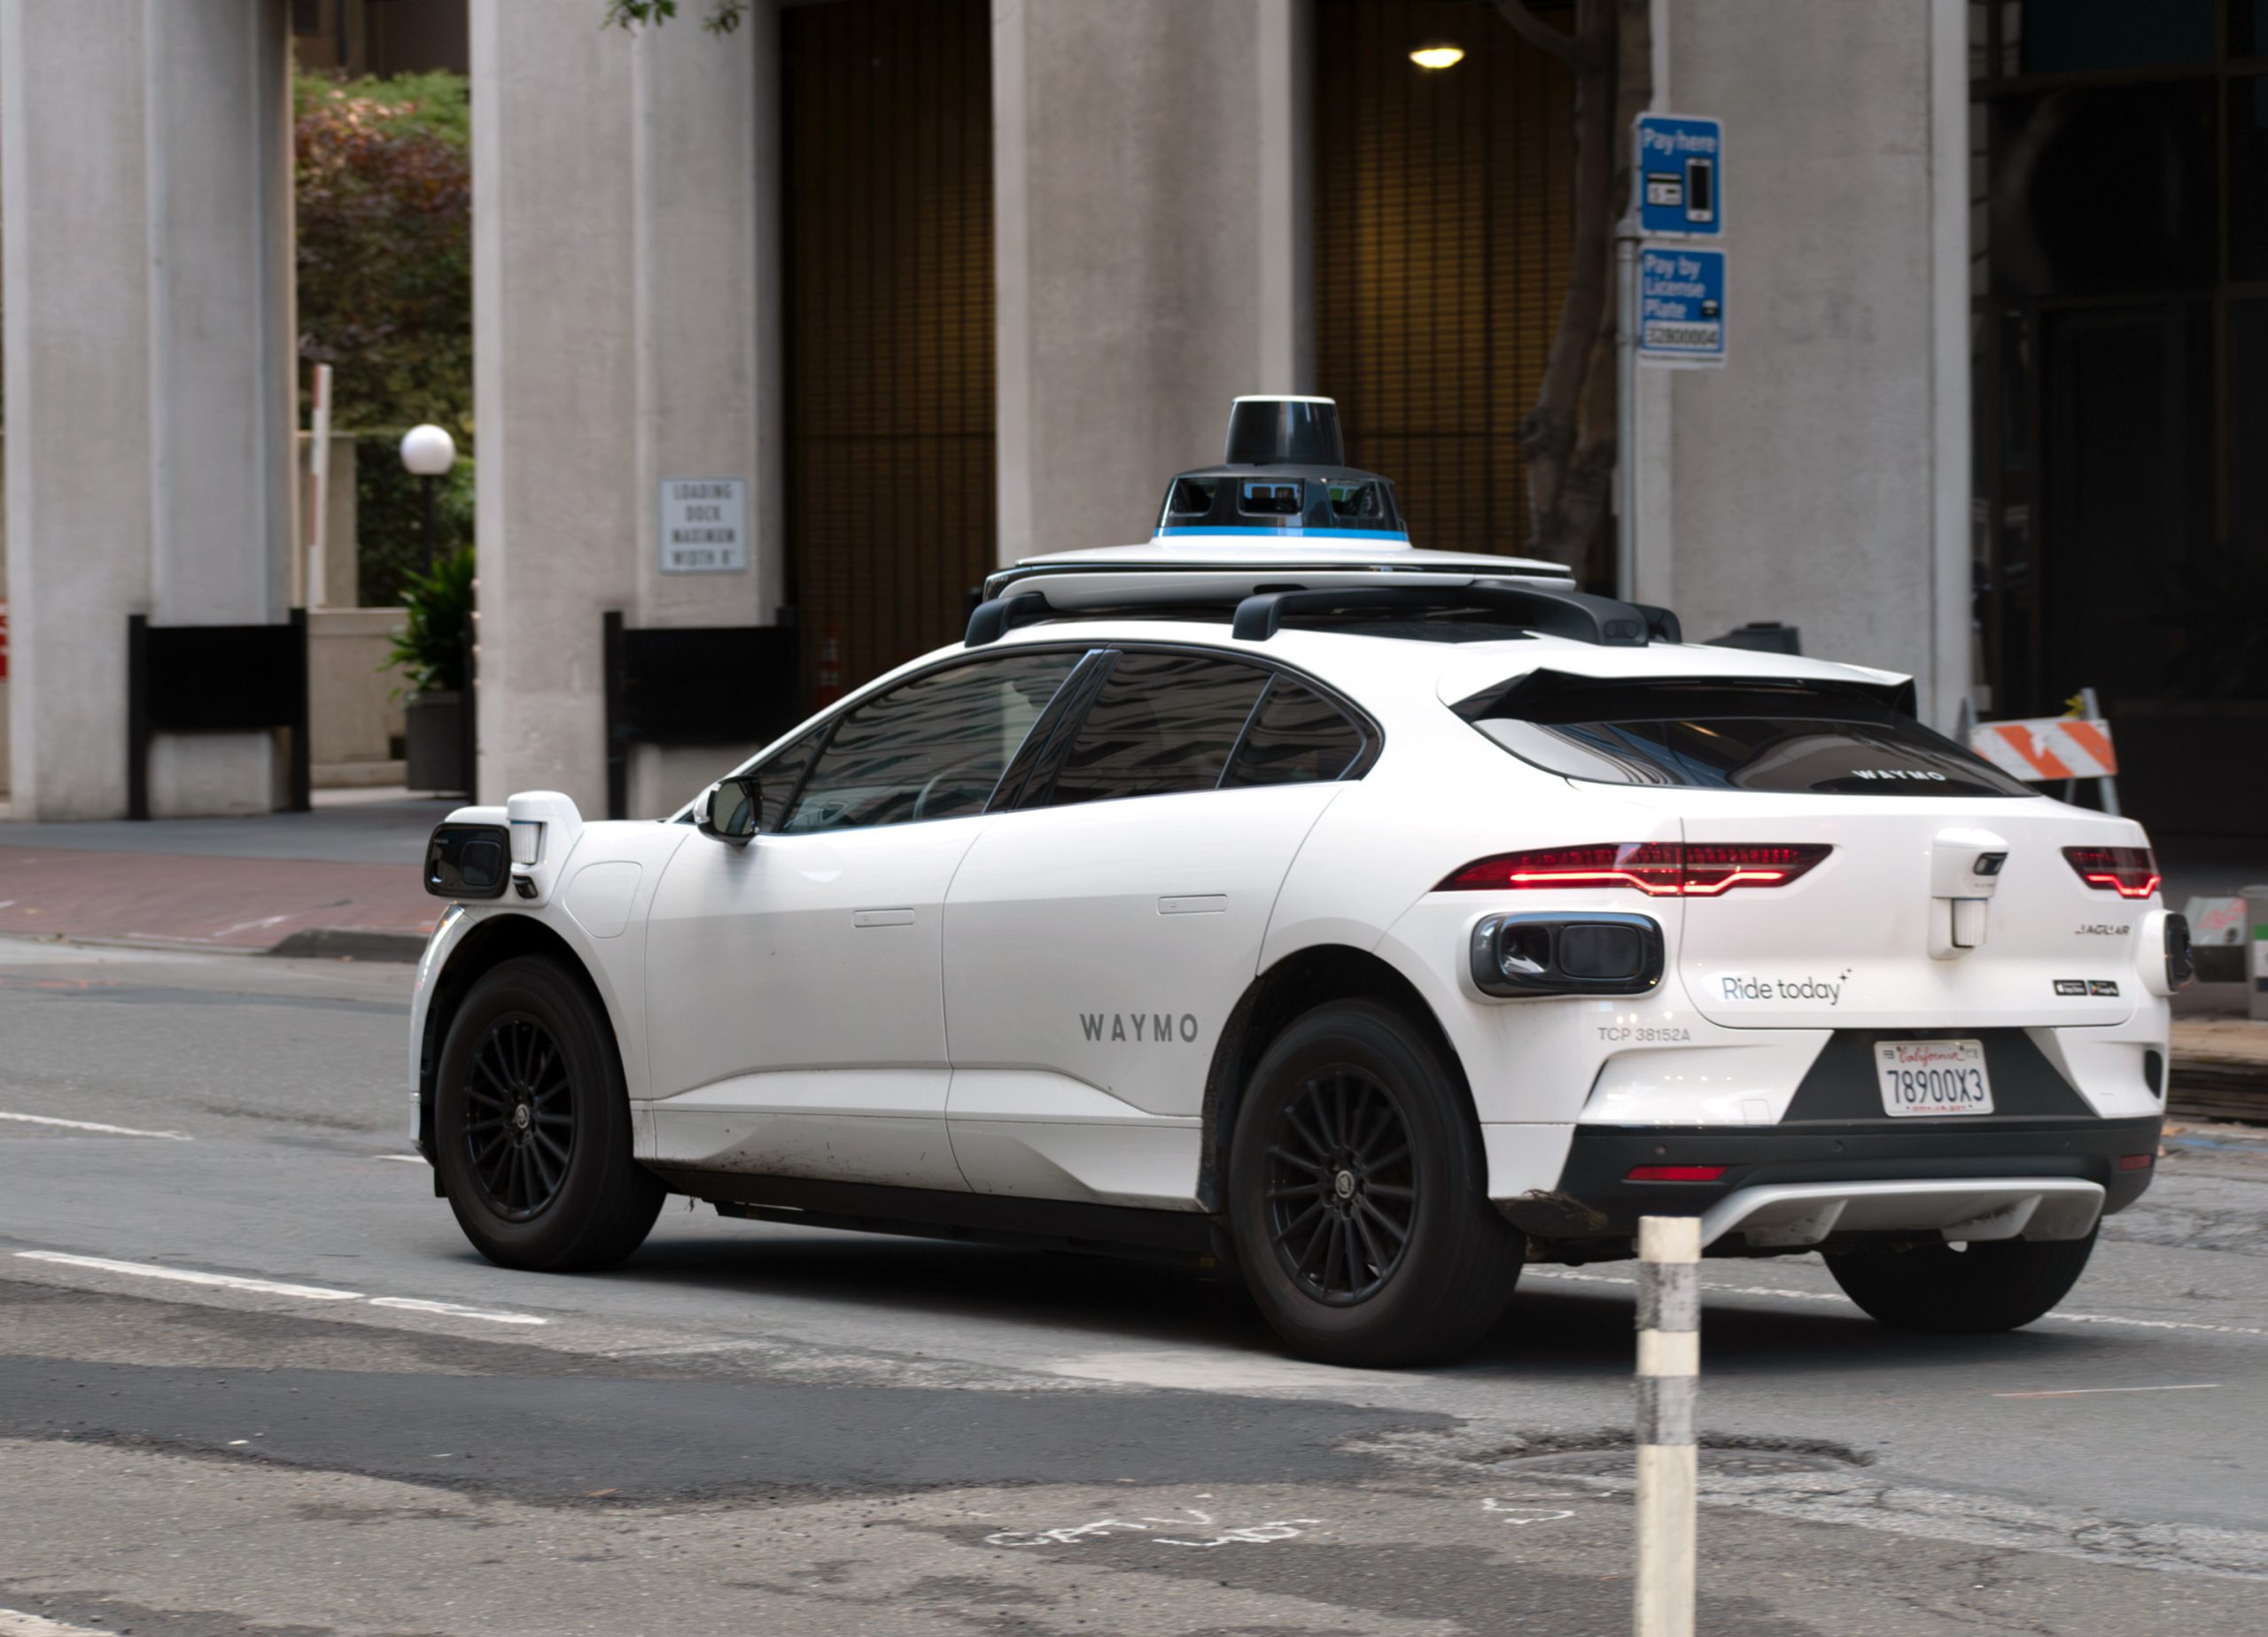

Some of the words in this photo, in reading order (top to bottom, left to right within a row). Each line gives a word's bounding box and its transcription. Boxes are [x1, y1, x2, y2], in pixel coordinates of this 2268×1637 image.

[1643, 128, 1674, 156] Pay
[1645, 253, 1675, 280] Pay
[1678, 255, 1702, 281] by
[1645, 277, 1705, 298] License
[1645, 298, 1687, 320] Plate
[672, 484, 734, 500] LOADING
[685, 505, 721, 522] DOCK
[672, 529, 735, 544] MAXIMUM
[672, 549, 715, 566] WIDTH
[1851, 769, 1946, 781] WAYMO
[2074, 925, 2130, 935] JAGUAR
[1721, 976, 1773, 999] Ride
[1776, 976, 1840, 1005] today
[1079, 1013, 1199, 1043] WAYMO
[1597, 1027, 1631, 1042] TCP
[1635, 1027, 1691, 1042] 38152A
[1897, 1046, 1965, 1067] California
[1886, 1068, 1985, 1105] 78900X3
